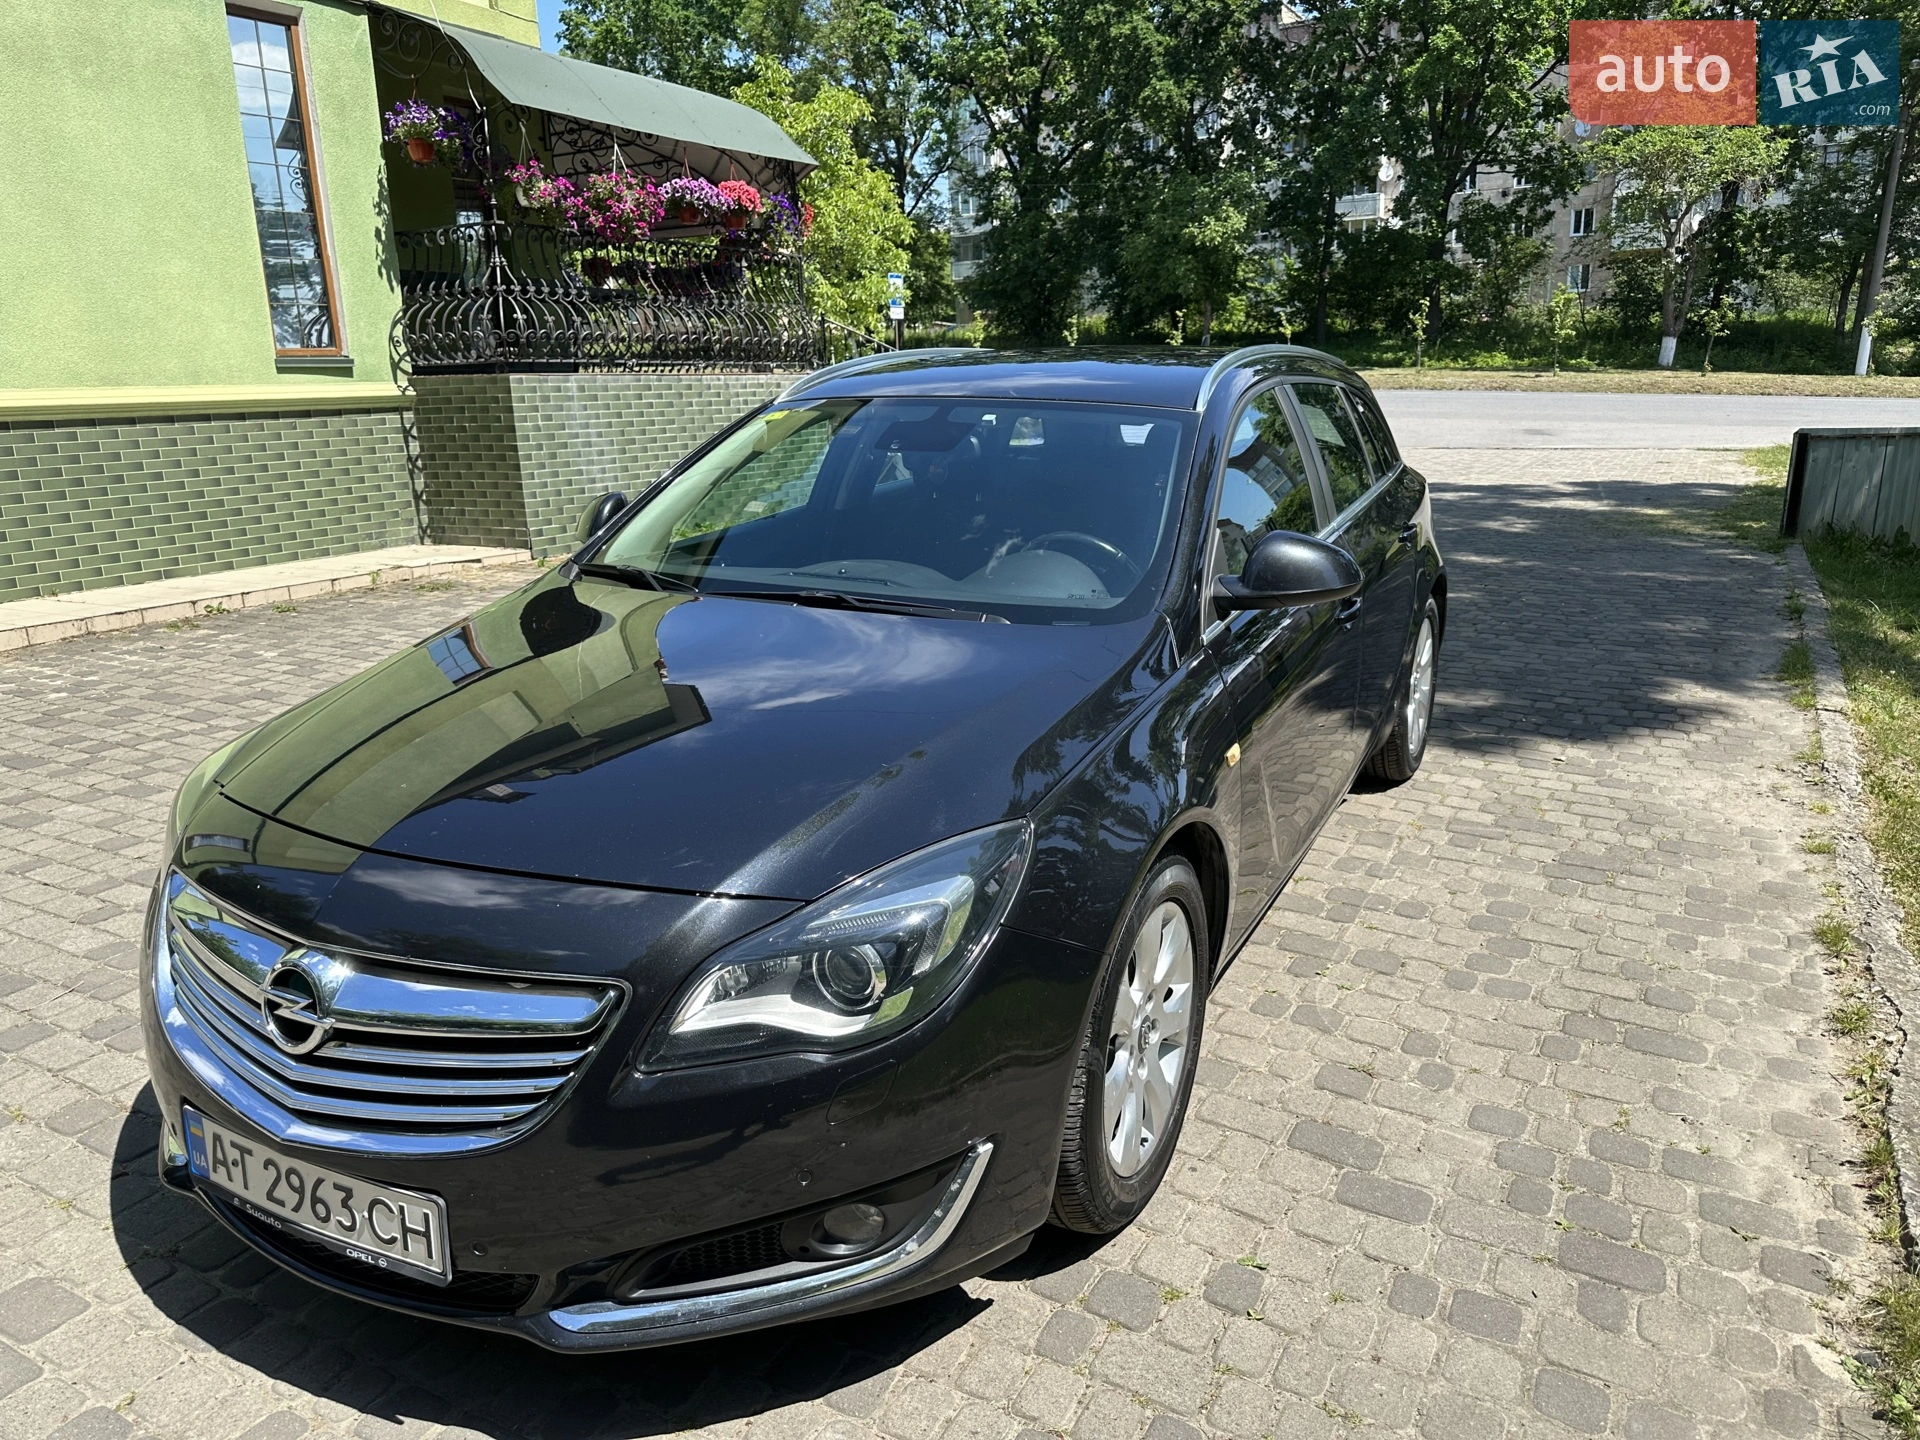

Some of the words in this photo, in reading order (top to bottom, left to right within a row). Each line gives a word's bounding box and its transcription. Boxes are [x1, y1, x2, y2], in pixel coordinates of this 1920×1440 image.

[193, 1150, 208, 1169] UA
[212, 1131, 253, 1191] AT
[263, 1158, 358, 1232] 2963
[368, 1197, 436, 1261] CH
[246, 1203, 282, 1229] Suauto
[346, 1248, 375, 1264] OPEL
